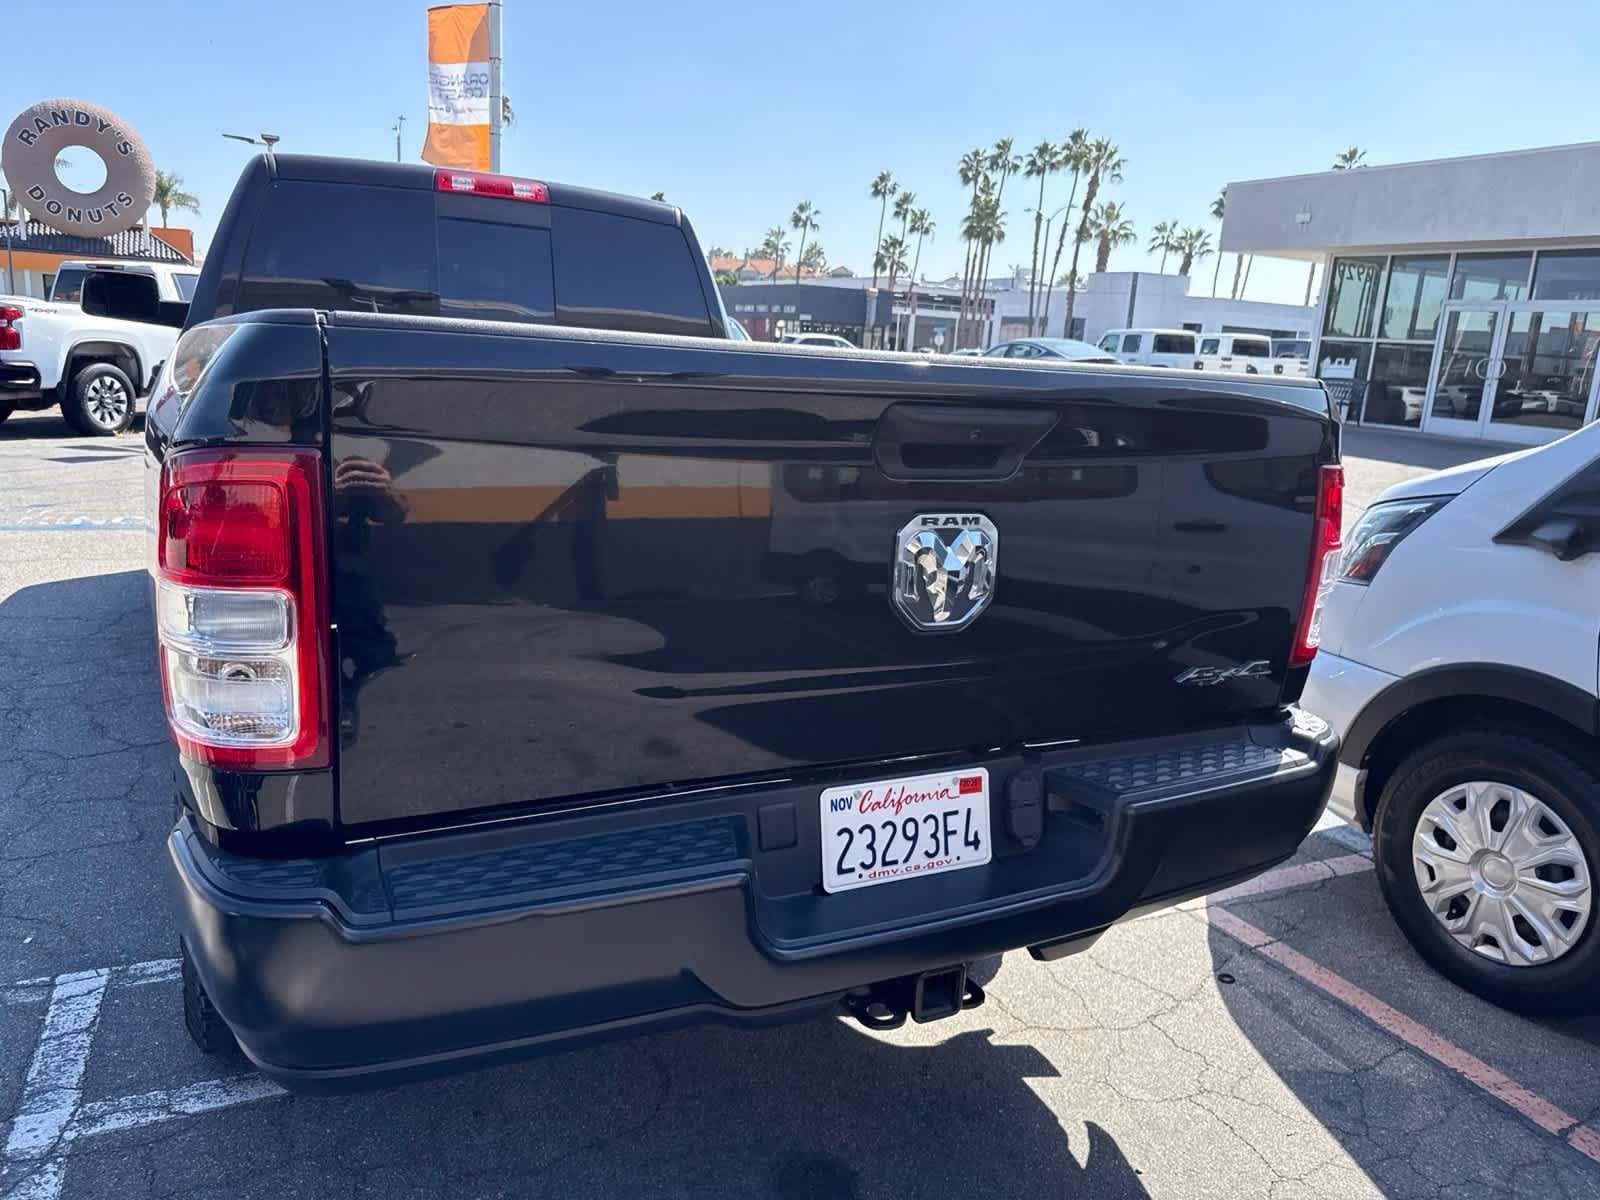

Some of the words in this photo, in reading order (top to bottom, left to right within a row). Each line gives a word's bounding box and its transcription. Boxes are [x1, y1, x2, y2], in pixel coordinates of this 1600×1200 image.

[17, 110, 133, 156] RANDY'S
[27, 184, 134, 224] DONUTS
[921, 517, 981, 526] RAM
[830, 797, 853, 813] NOV
[858, 784, 961, 816] California
[837, 807, 981, 876] 23293F4
[867, 858, 953, 880] dmv.ca.gov
